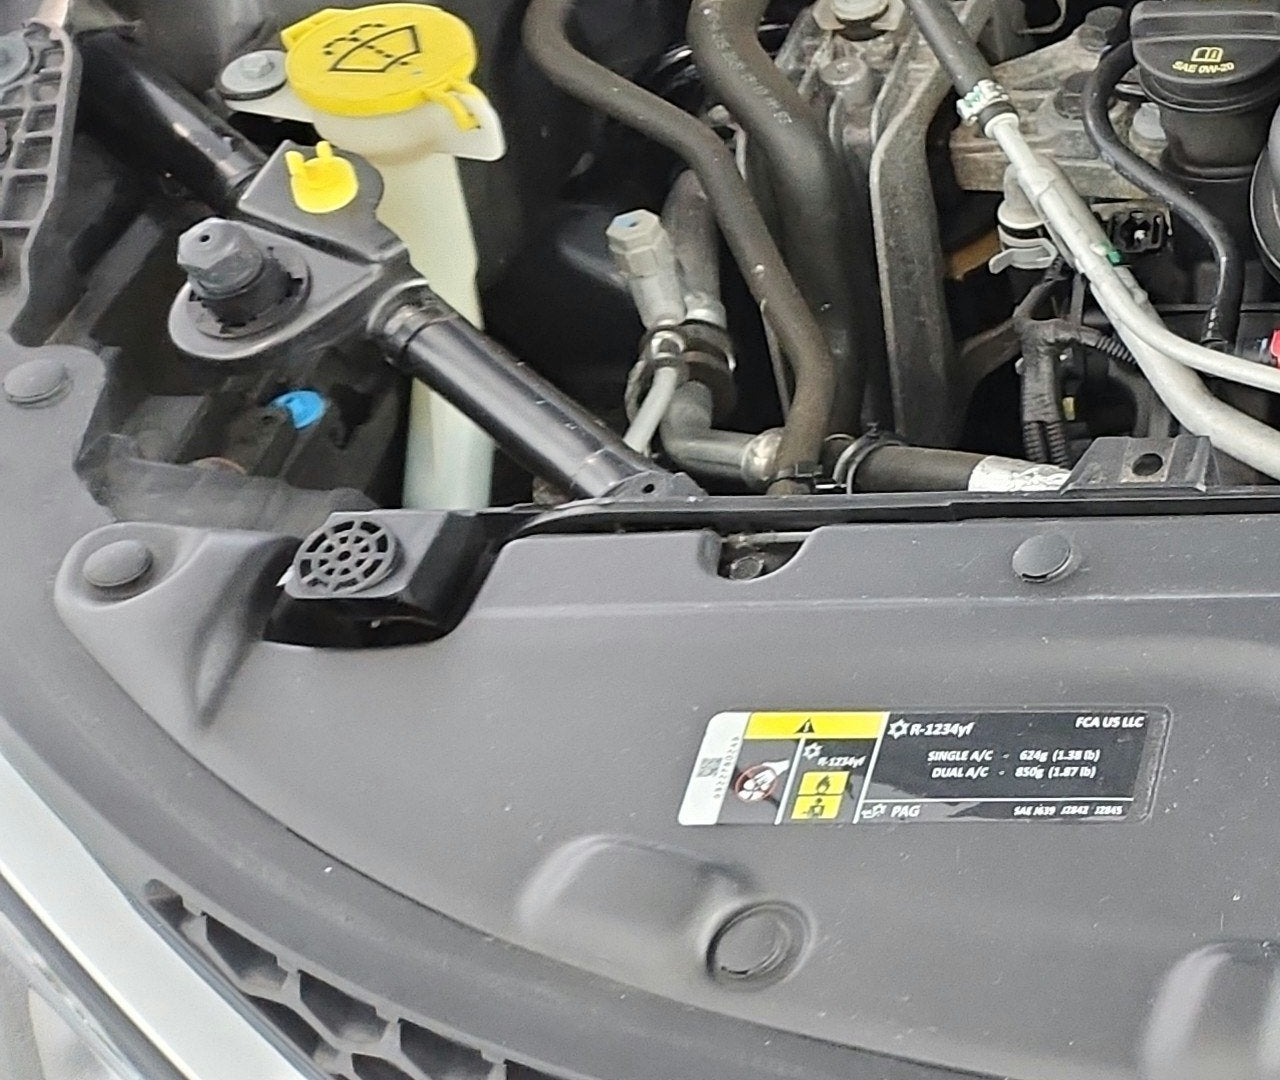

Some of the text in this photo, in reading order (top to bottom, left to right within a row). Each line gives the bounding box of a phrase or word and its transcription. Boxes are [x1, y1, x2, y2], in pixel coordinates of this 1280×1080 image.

[1172, 60, 1235, 74] SAE 0W-20
[1075, 716, 1145, 728] FCA US LLC
[909, 721, 975, 738] R-1234yf
[927, 750, 969, 762] SINGLE
[969, 749, 994, 763] A/C
[1019, 750, 1049, 763] 624g
[1083, 749, 1101, 763] lb)
[931, 767, 964, 779] DUAL
[964, 766, 990, 779] A/C
[1015, 767, 1045, 780] 850g
[1079, 766, 1097, 779] lb)
[890, 804, 921, 818] PAG
[1013, 805, 1033, 816] SAE
